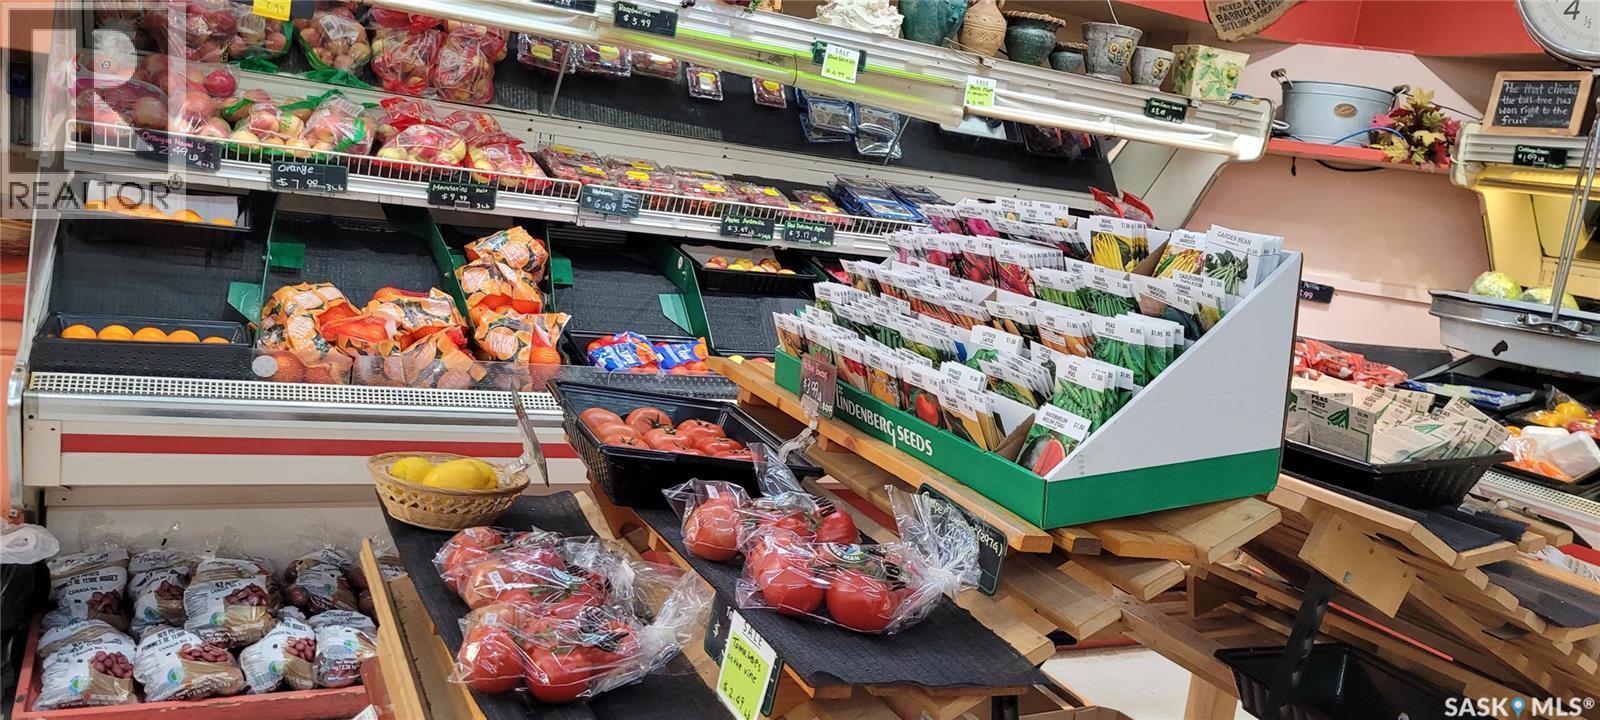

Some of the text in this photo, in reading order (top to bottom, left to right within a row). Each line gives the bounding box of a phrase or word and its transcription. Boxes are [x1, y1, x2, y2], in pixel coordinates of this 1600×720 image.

[1216, 5, 1257, 24] BARRICH
[1563, 0, 1580, 20] 4
[1523, 83, 1545, 95] that
[1547, 82, 1578, 95] climbs
[1501, 94, 1572, 105] the tall tree has
[1499, 106, 1568, 115] won right to the
[278, 164, 314, 174] Orange
[1217, 231, 1237, 241] GARDEN
[1237, 236, 1252, 246] BEAN
[1311, 394, 1328, 403] PEAS
[1311, 399, 1326, 408] POIS
[897, 424, 933, 457] SEEDS
[68, 587, 90, 596] CANADA
[743, 621, 762, 648] SALE
[744, 668, 757, 684] vine
